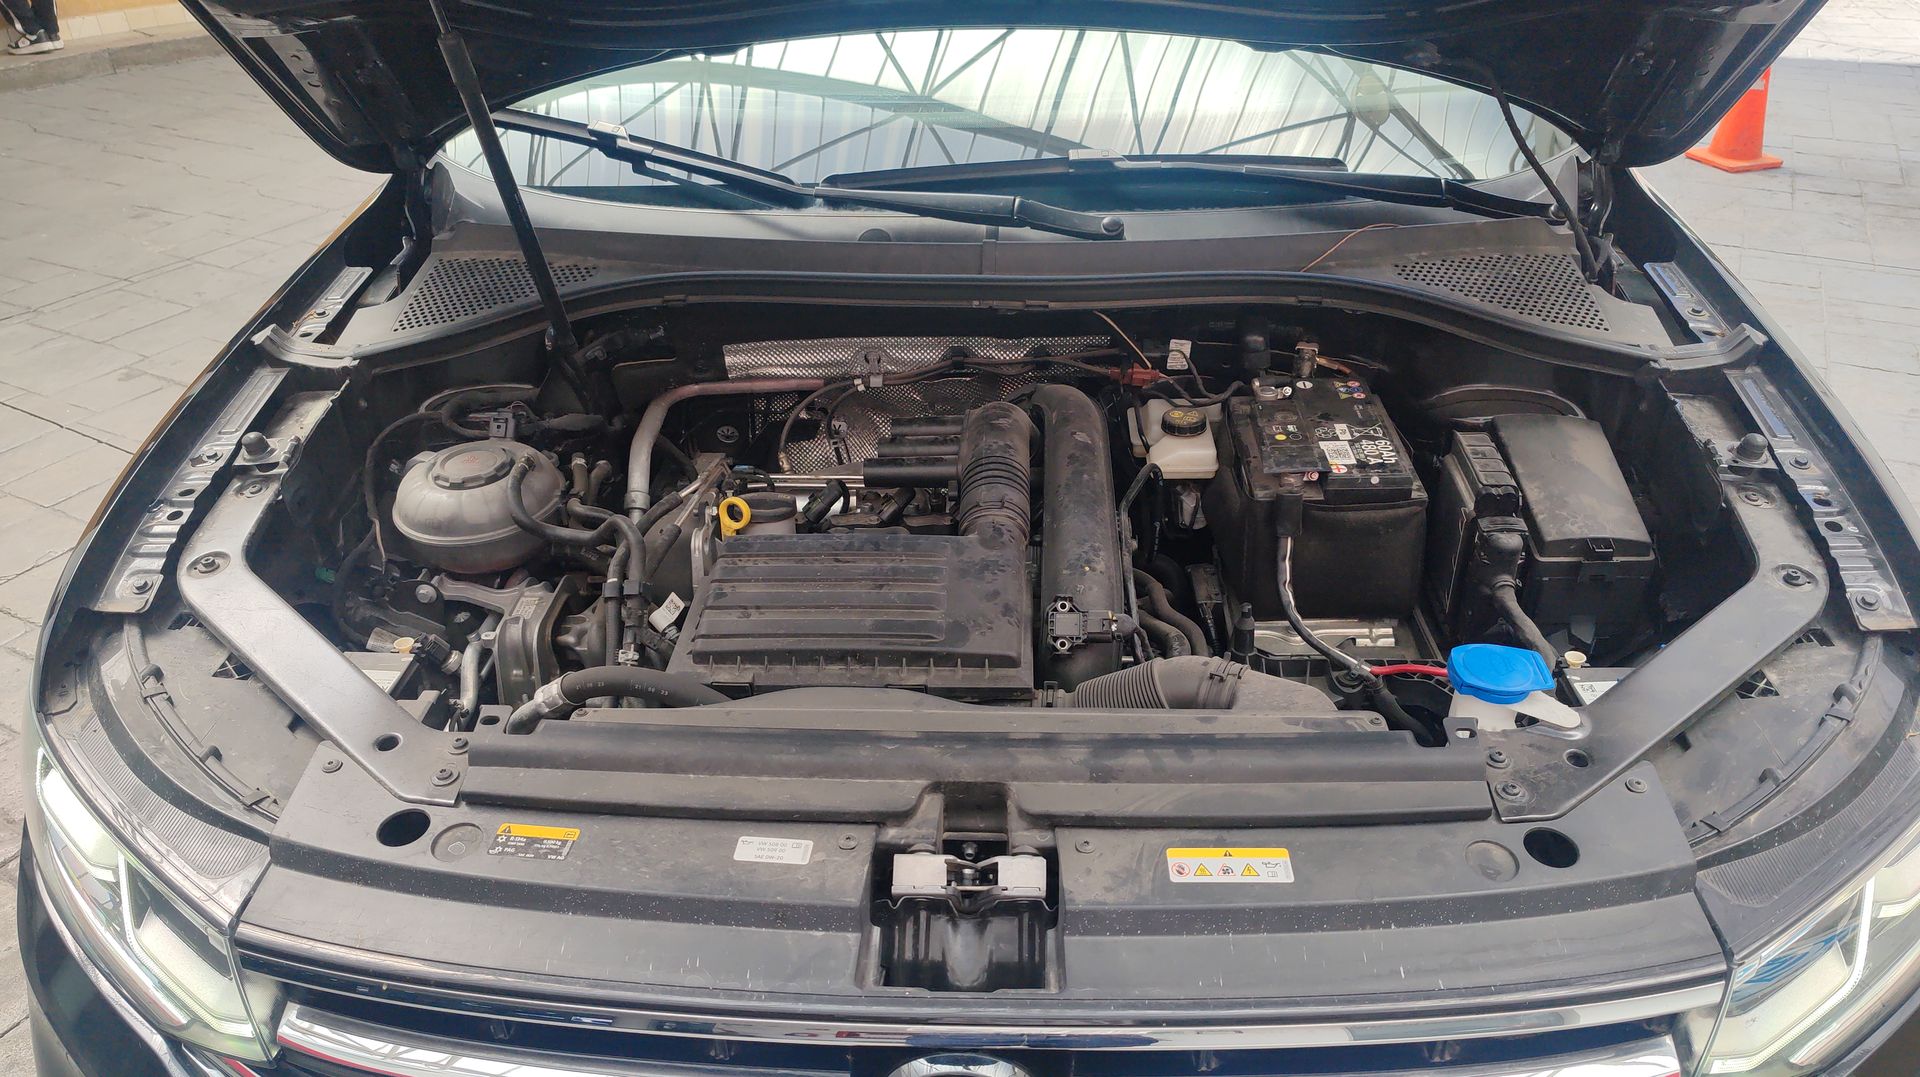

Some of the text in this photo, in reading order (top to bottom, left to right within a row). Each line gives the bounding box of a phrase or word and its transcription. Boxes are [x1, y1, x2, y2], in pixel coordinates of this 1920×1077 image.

[1360, 439, 1379, 456] 480
[1375, 439, 1398, 464] 60Ah
[1366, 457, 1384, 465] A
